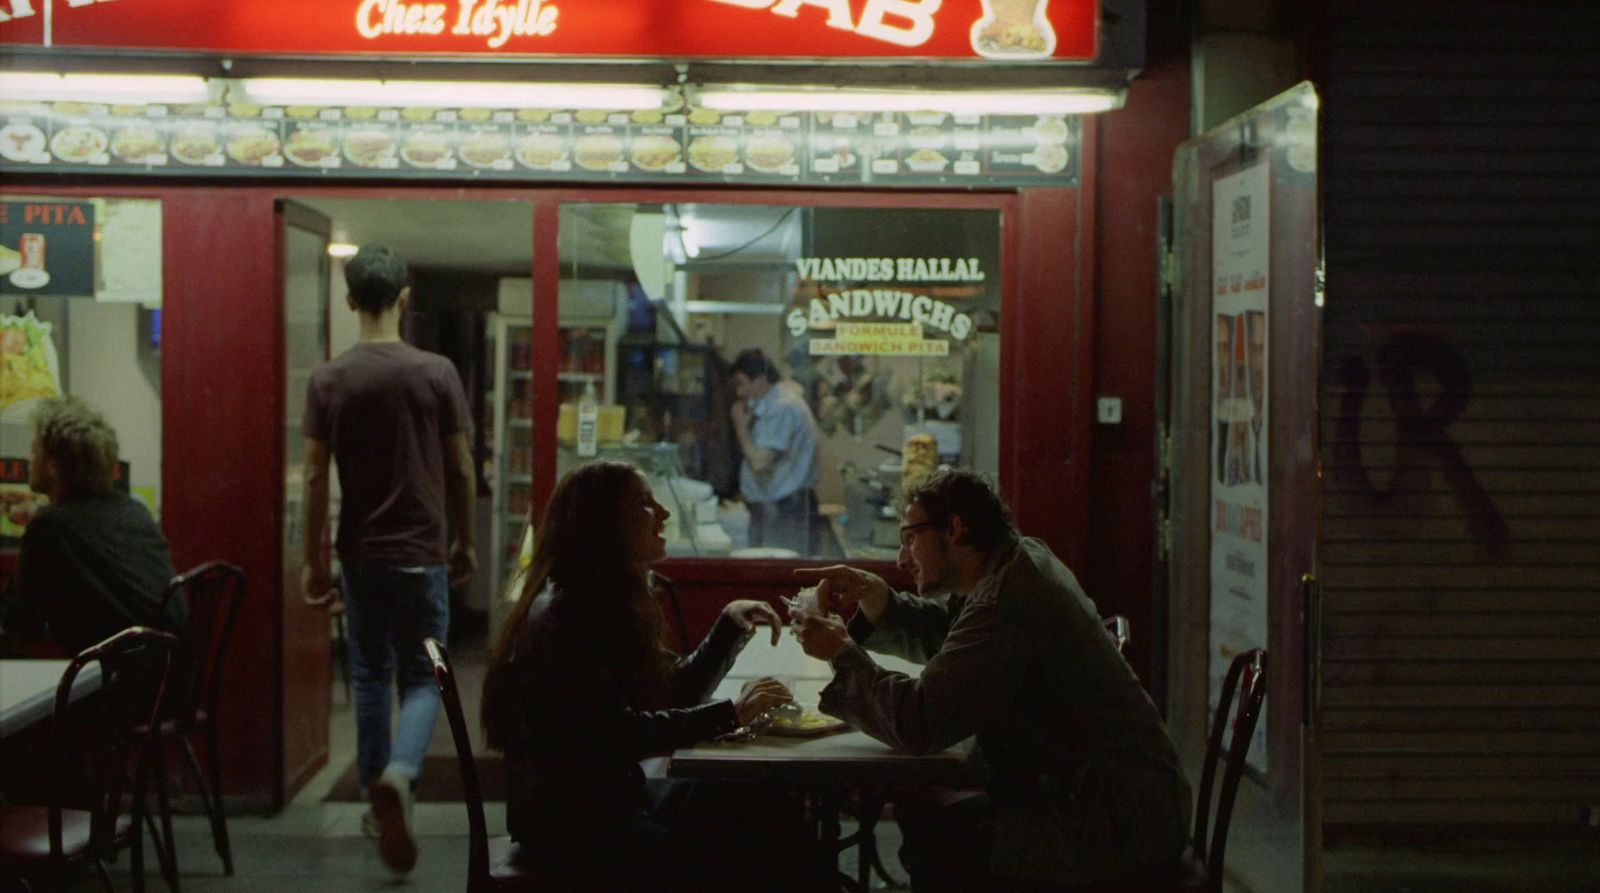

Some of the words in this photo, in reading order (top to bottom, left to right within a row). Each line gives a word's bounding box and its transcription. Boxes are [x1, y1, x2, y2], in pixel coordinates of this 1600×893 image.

[356, 0, 446, 39] Chez
[451, 0, 560, 48] Idylle
[24, 203, 86, 225] PITA
[796, 257, 894, 281] VIANDES
[897, 257, 985, 282] HALLAL
[786, 289, 972, 341] SANDWICHS
[839, 324, 919, 336] FORMULE
[811, 341, 903, 352] SANDWICH
[909, 341, 946, 353] PITA
